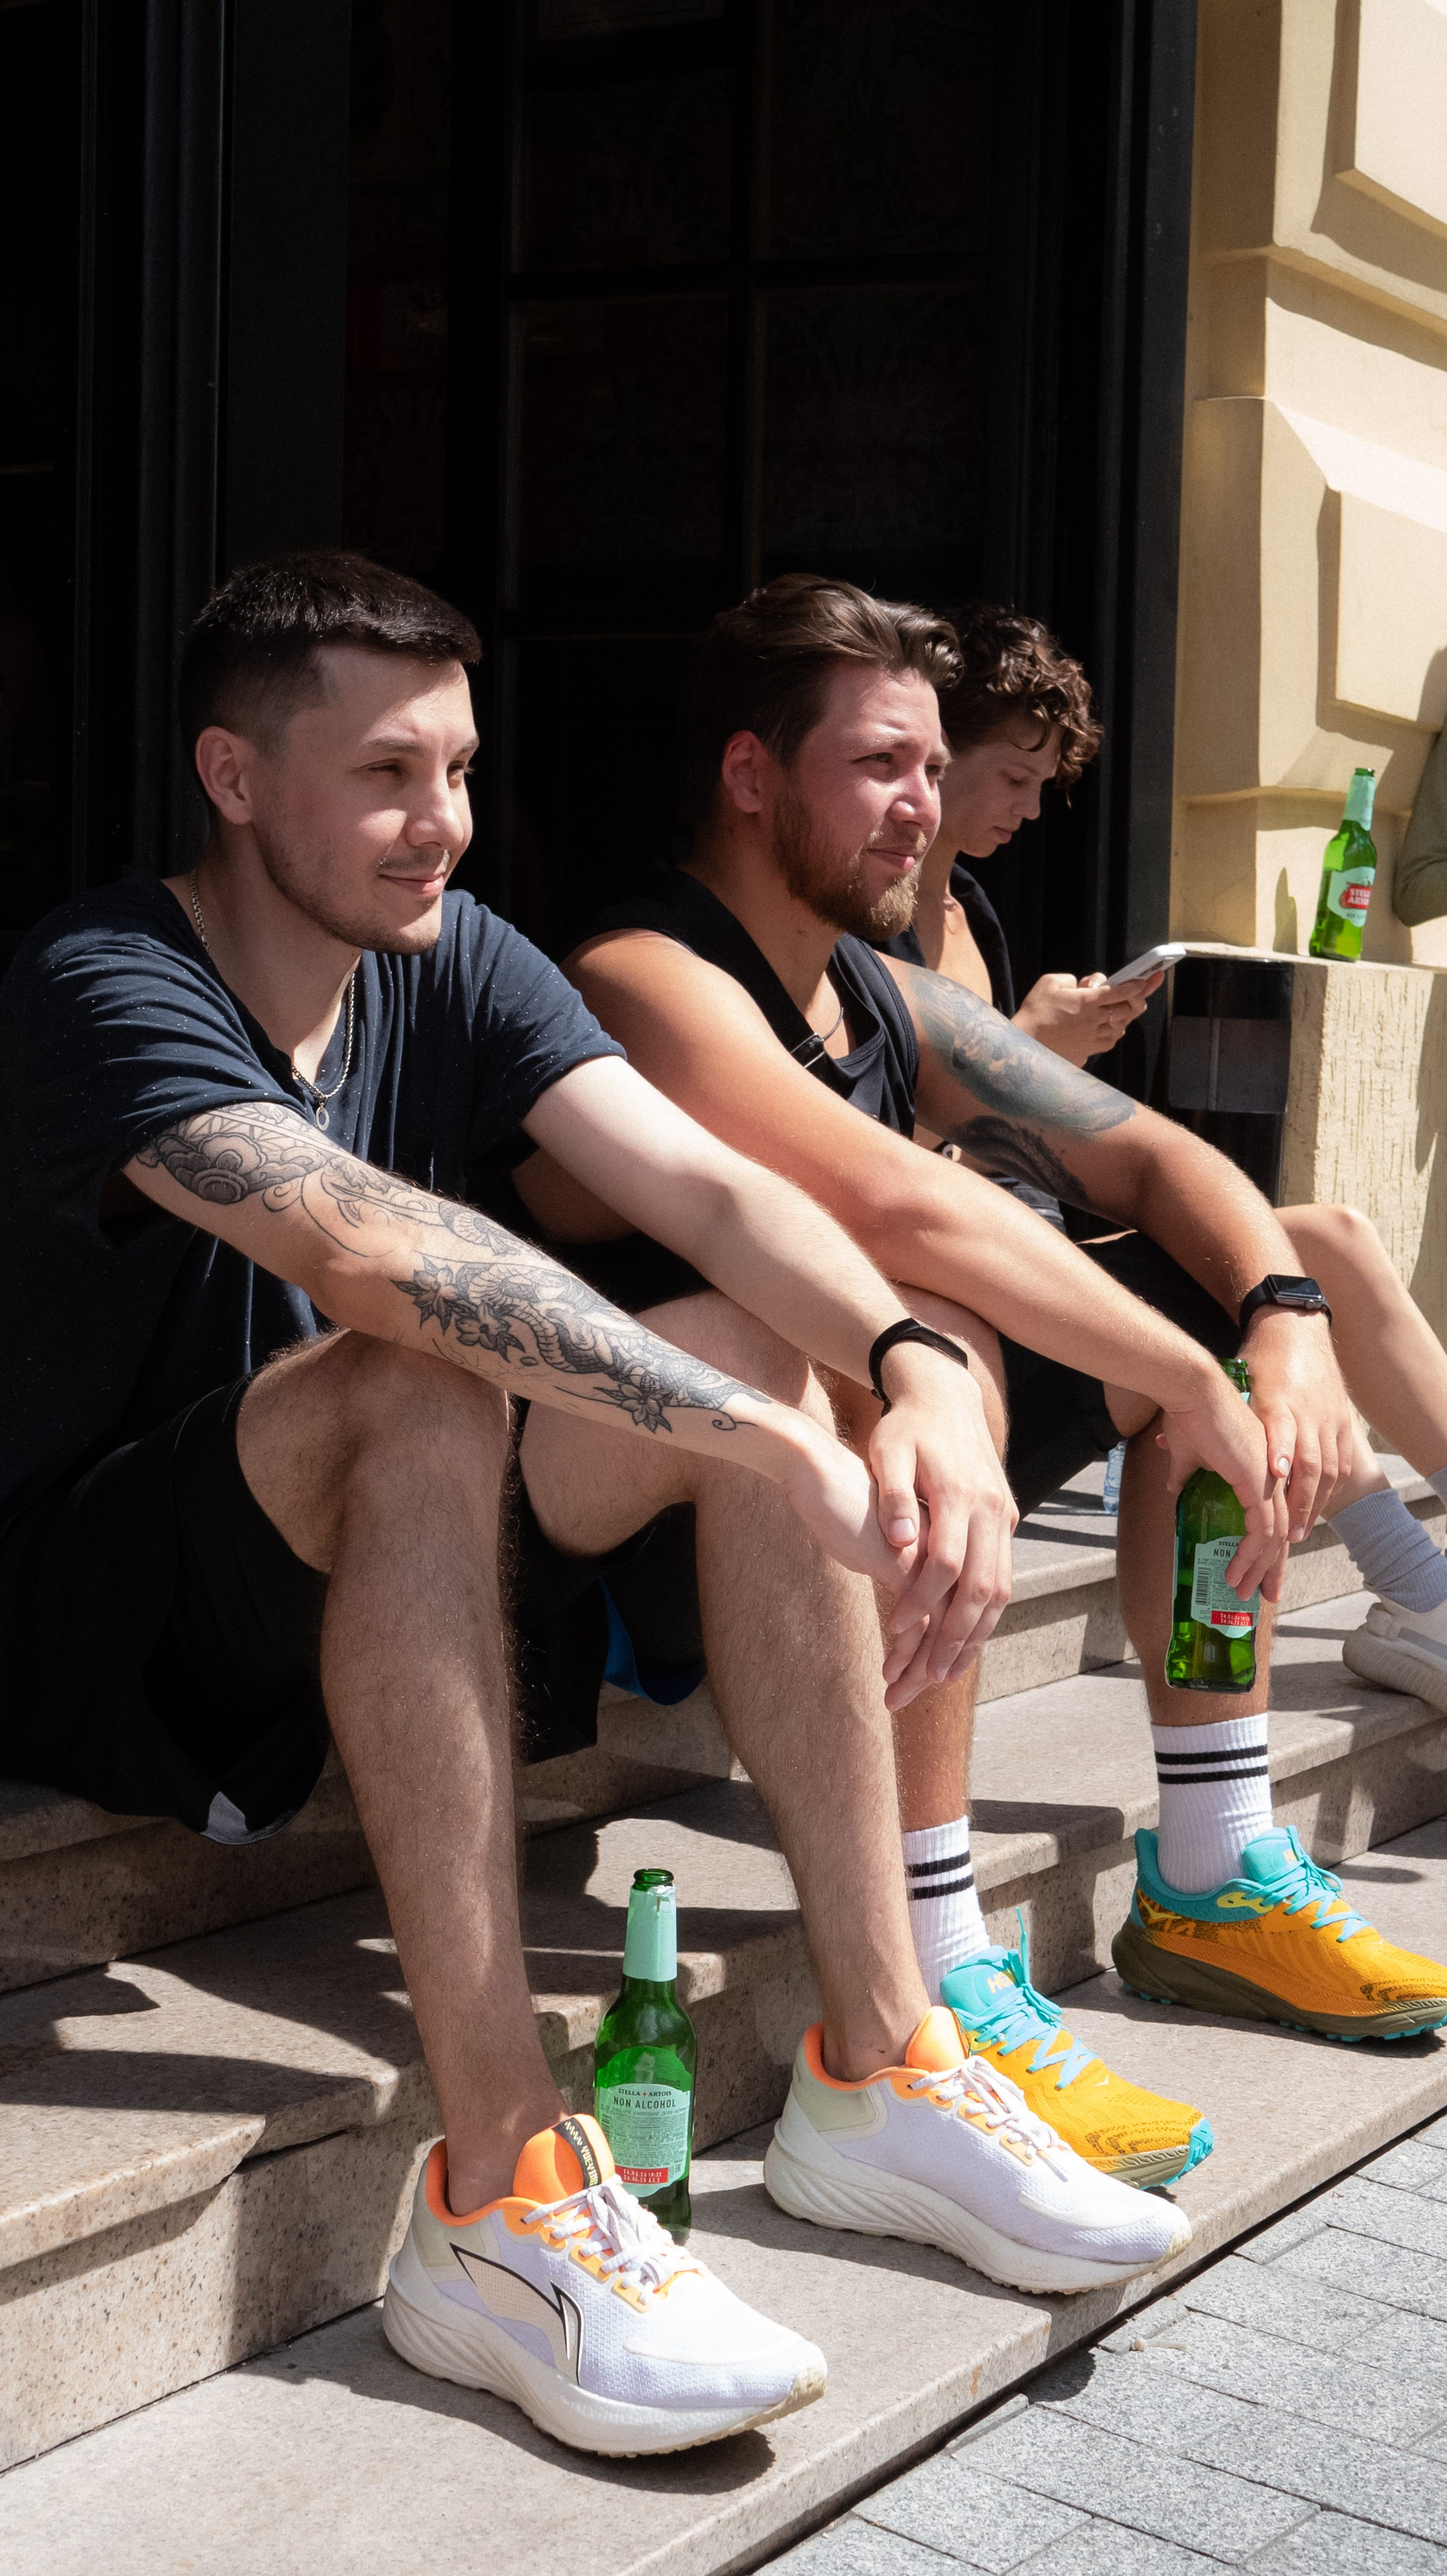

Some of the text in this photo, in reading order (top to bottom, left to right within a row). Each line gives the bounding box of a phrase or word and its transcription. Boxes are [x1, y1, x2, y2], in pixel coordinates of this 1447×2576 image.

[1350, 888, 1371, 898] STELL
[1348, 896, 1370, 905] ARTO
[1214, 1548, 1231, 1557] NON
[986, 1972, 1012, 1994] HO
[614, 2096, 675, 2109] NON ALCOHOL
